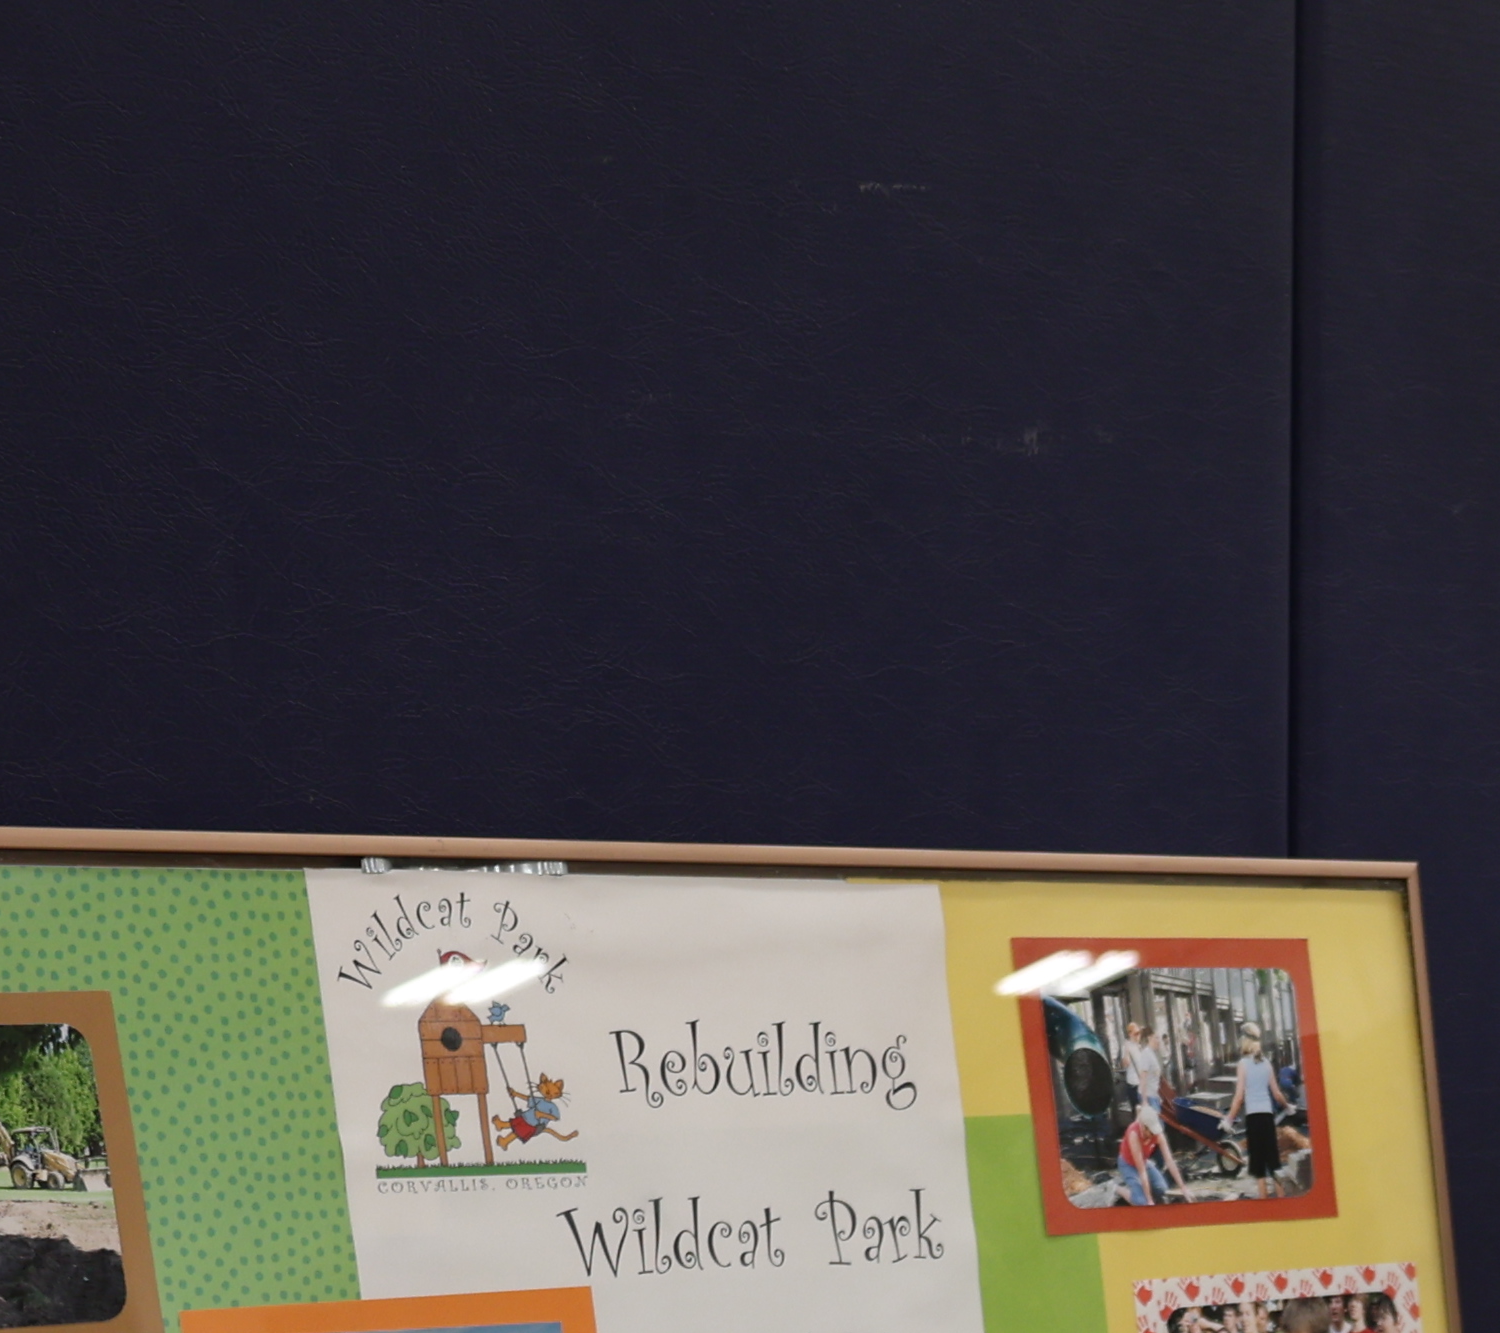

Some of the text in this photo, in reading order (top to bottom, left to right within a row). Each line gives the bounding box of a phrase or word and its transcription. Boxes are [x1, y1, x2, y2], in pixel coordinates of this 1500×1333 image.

[337, 892, 572, 994] Wildcat Park
[609, 1020, 917, 1110] Rebuilding
[506, 1175, 588, 1191] OREGON
[556, 1187, 945, 1278] Wildcat Park
